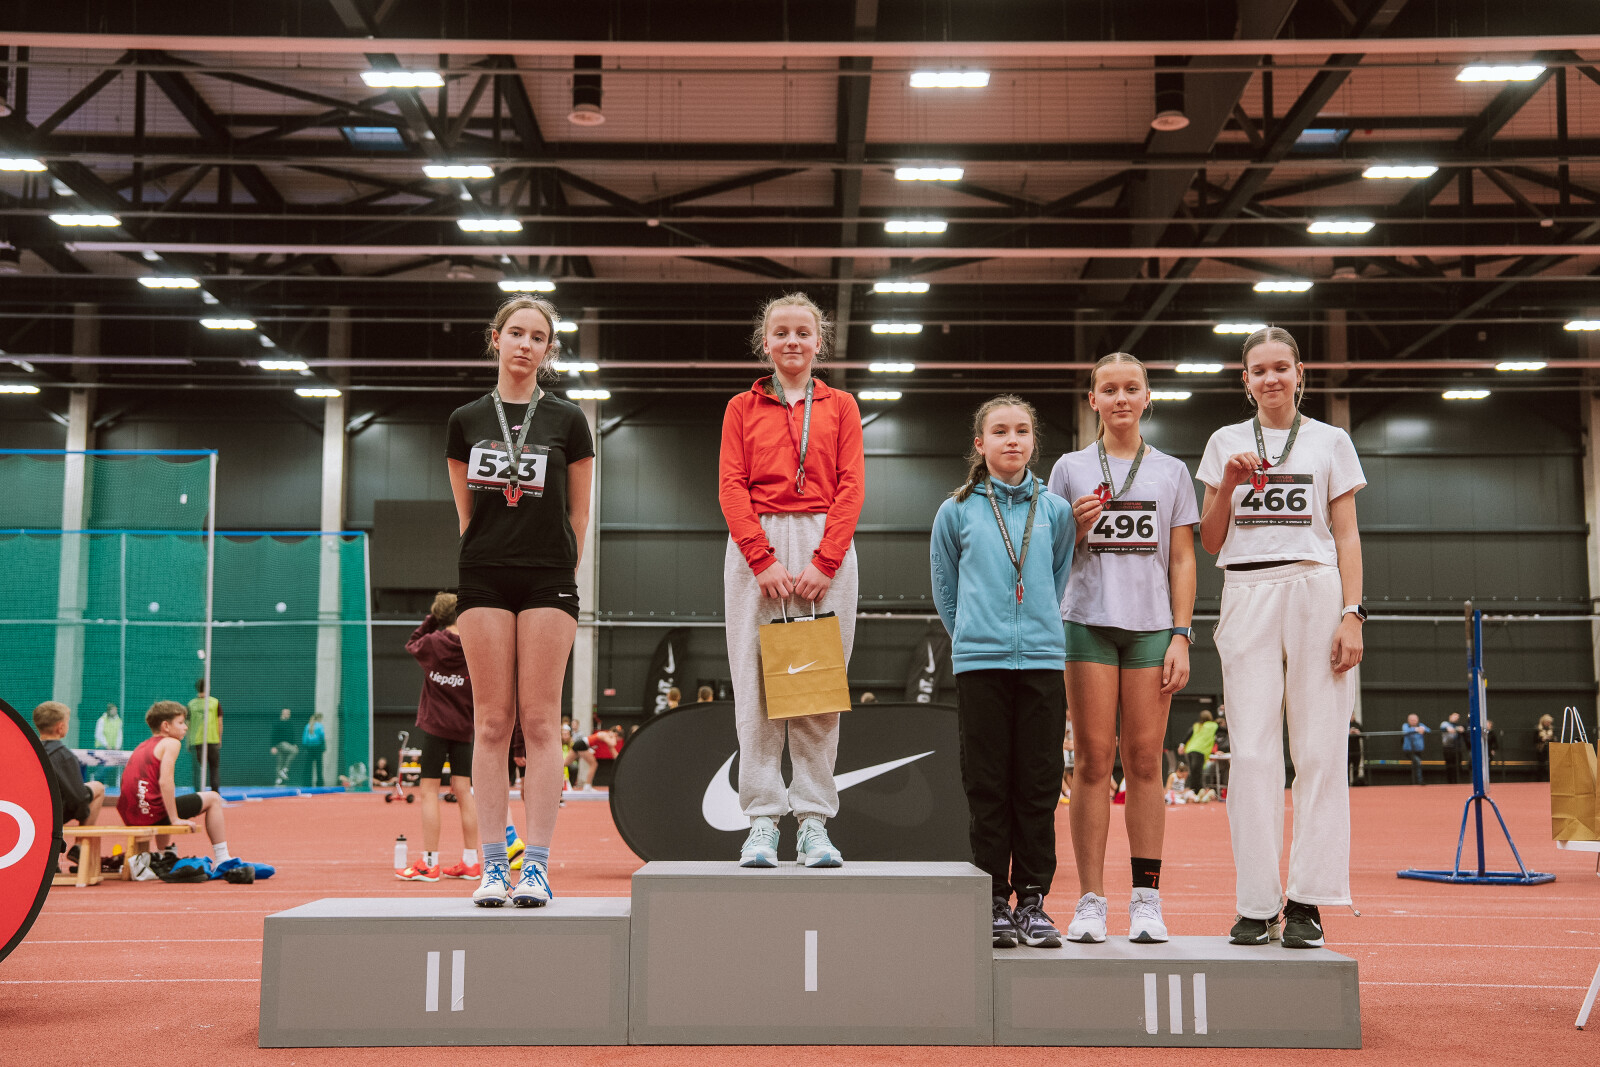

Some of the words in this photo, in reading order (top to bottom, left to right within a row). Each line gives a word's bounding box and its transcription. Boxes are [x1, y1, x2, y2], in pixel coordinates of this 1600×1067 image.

[477, 453, 537, 482] 523
[1241, 488, 1307, 511] 466
[1093, 515, 1154, 539] 496
